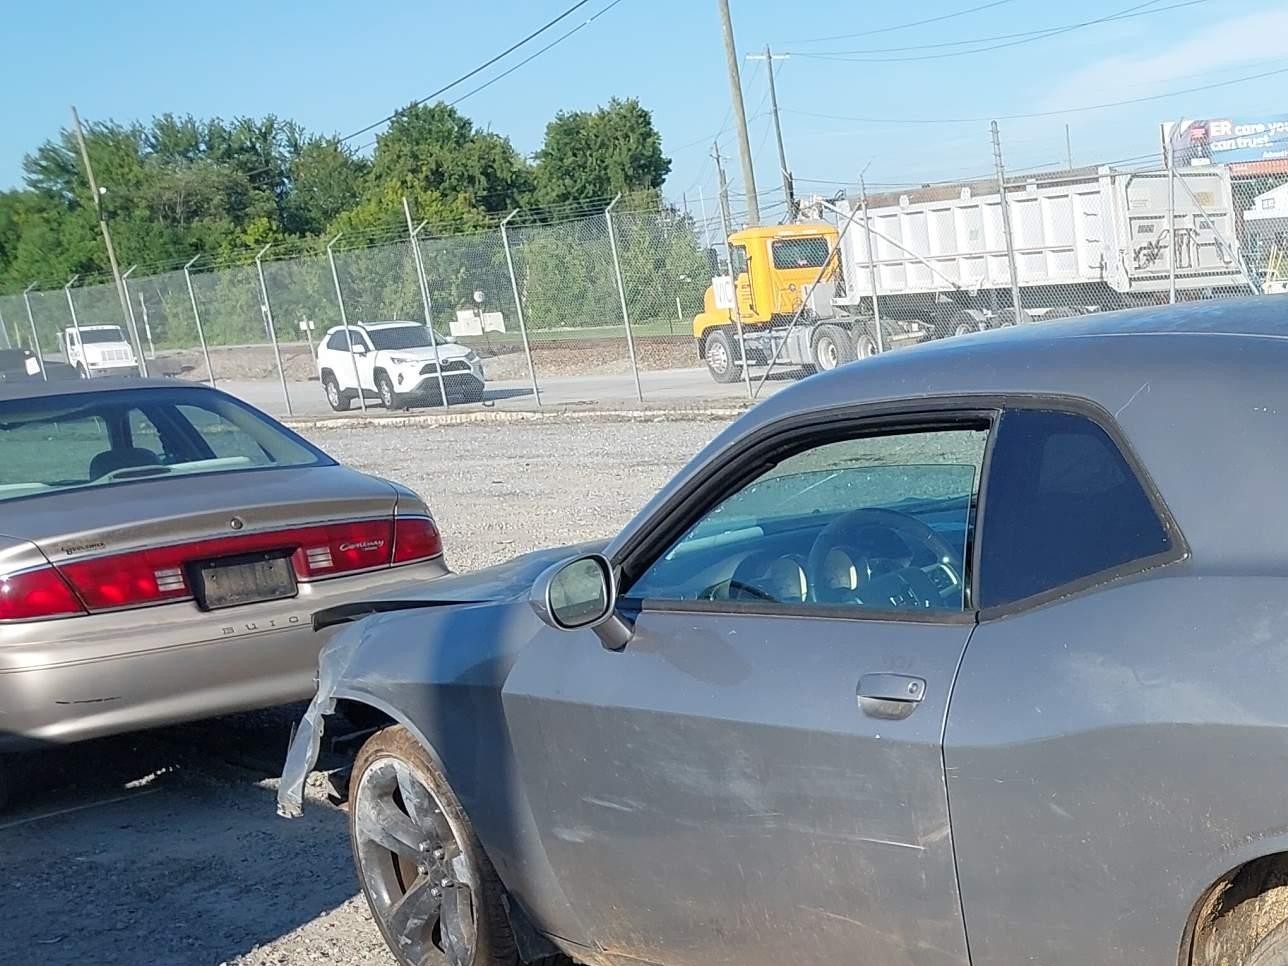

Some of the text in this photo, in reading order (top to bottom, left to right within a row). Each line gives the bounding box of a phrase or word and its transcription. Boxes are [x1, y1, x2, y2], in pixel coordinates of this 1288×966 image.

[1210, 122, 1232, 136] ER
[1235, 123, 1265, 135] care
[1210, 140, 1236, 150] can
[222, 616, 299, 634] BUIC
